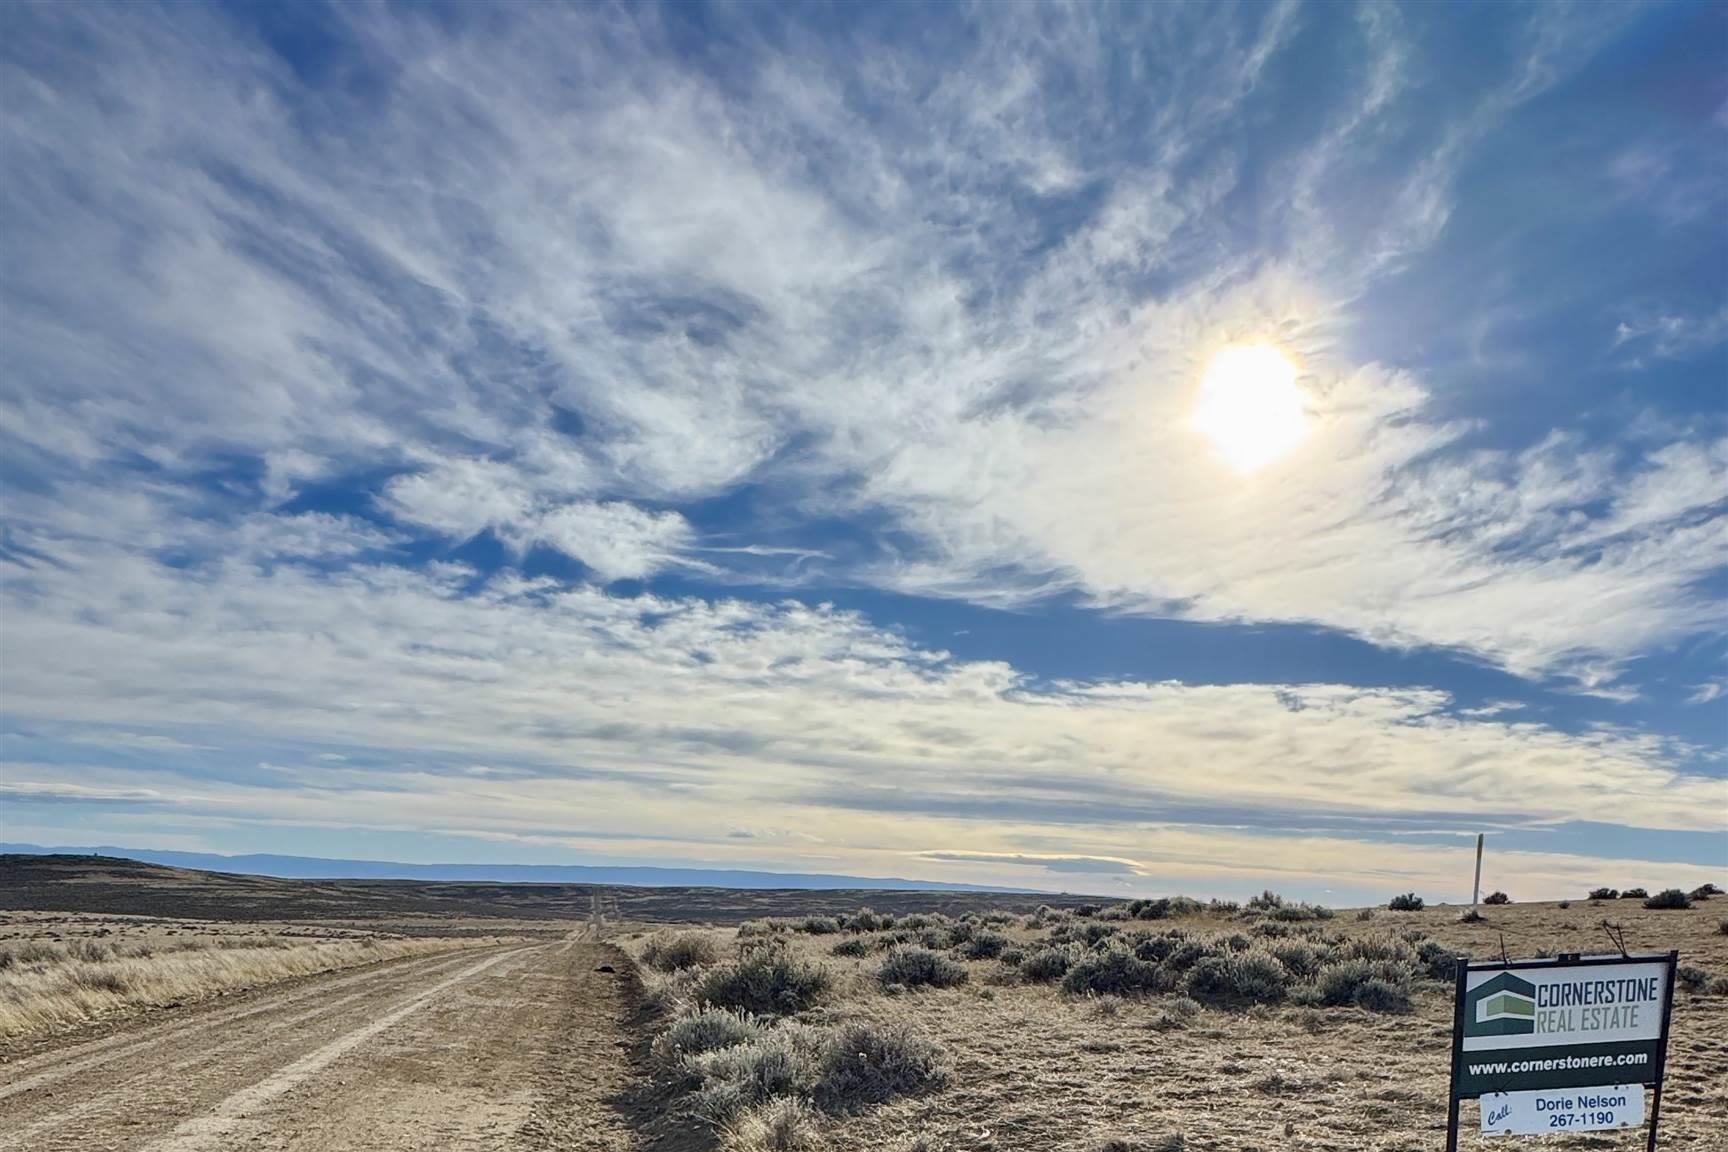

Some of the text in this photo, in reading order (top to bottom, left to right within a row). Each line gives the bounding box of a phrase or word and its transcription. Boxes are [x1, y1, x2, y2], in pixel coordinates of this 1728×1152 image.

[1537, 977, 1658, 1008] CORNERSTONE
[1536, 1004, 1639, 1034] REAL ESTATE
[1469, 1052, 1648, 1076] www.cornerstonere.com
[1536, 1092, 1626, 1112] Dorie Nelson
[1550, 1111, 1614, 1128] 267-1190
